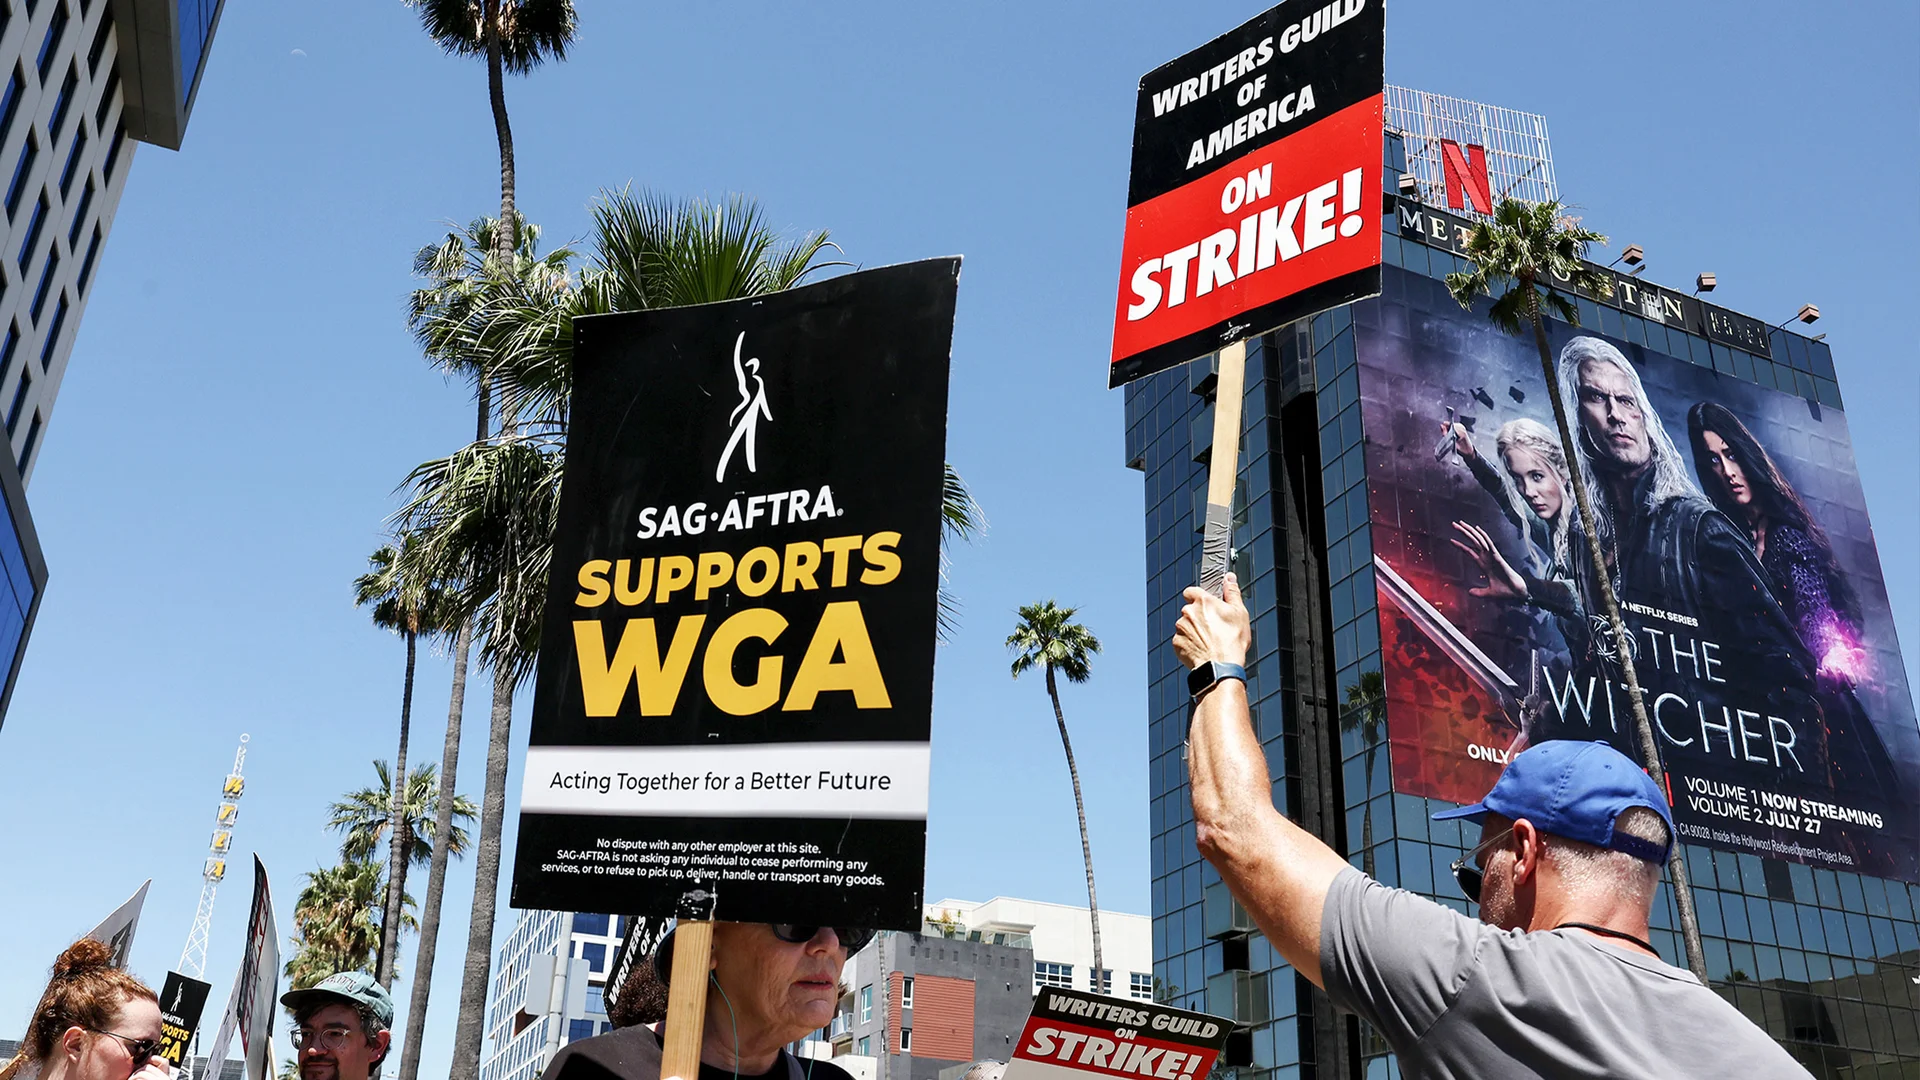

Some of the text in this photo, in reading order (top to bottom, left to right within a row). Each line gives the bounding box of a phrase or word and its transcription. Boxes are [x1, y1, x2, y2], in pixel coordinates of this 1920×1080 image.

[1152, 0, 1366, 118] WRITERS GUILD
[1236, 74, 1267, 107] OF
[1185, 84, 1316, 171] AMERICA
[1220, 162, 1272, 215] ON
[1127, 167, 1364, 321] STRIKE!
[575, 531, 902, 608] SUPPORTS
[1621, 601, 1699, 628] A NETFLIX SERIES
[572, 600, 893, 718] WGA
[1642, 626, 1726, 683] THE
[1467, 743, 1510, 765] ONLY
[550, 771, 891, 795] Acting Together for a Better Future
[1684, 776, 1883, 829] VOLUME 1 NOW STREAMING
[1687, 795, 1822, 835] VOLUME 2 JULY 27
[596, 838, 821, 854] No dispute with any other employer at this site.
[612, 851, 620, 862] is
[622, 852, 638, 863] not
[640, 853, 670, 866] asking
[671, 855, 689, 866] any
[691, 854, 738, 866] individual
[739, 857, 749, 866] to
[751, 858, 780, 867] cease
[782, 856, 844, 872] performing
[846, 860, 868, 872] any
[1680, 823, 1691, 836] CA
[1712, 829, 1730, 843] Inside
[1731, 832, 1741, 845] the
[1741, 834, 1771, 850] Hollywood
[1817, 848, 1838, 864] Project
[541, 863, 885, 887] services, or to refuse to pick up, deliver, handle or transport any goods.
[608, 915, 646, 1005] WRITERS
[640, 928, 651, 956] OF
[161, 1022, 190, 1041] PORTS
[1048, 994, 1219, 1039] WRITERS GUILD
[1114, 1027, 1137, 1040] ON
[159, 1035, 181, 1063] GA
[1026, 1027, 1203, 1080] STRIKE!
